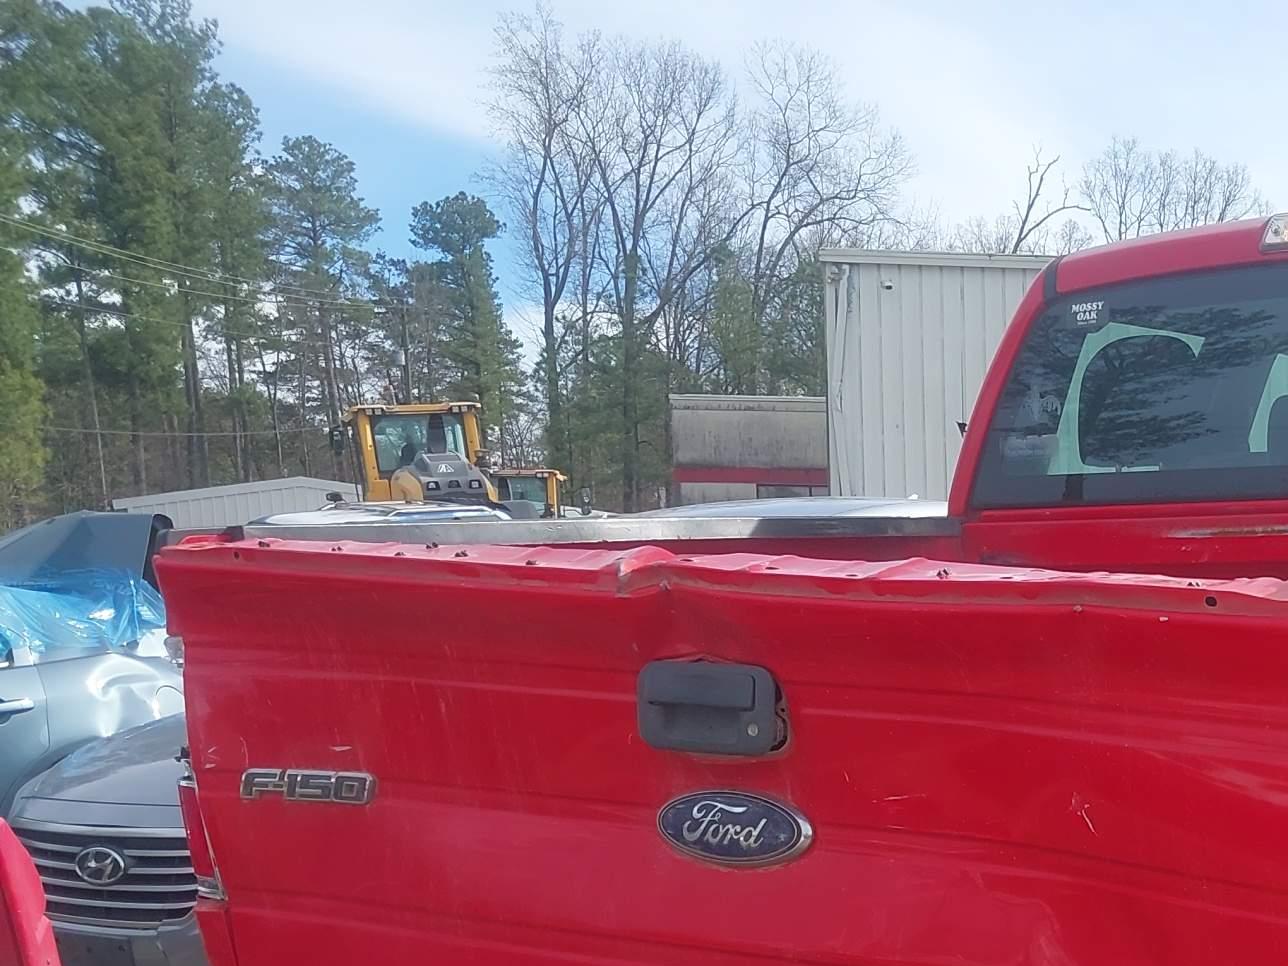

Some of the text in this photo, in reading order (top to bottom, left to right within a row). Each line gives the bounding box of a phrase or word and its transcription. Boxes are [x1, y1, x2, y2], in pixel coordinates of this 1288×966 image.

[1071, 301, 1104, 313] MOSSY
[1076, 311, 1098, 321] OAK
[240, 768, 376, 804] F-150
[682, 801, 768, 848] Ford
